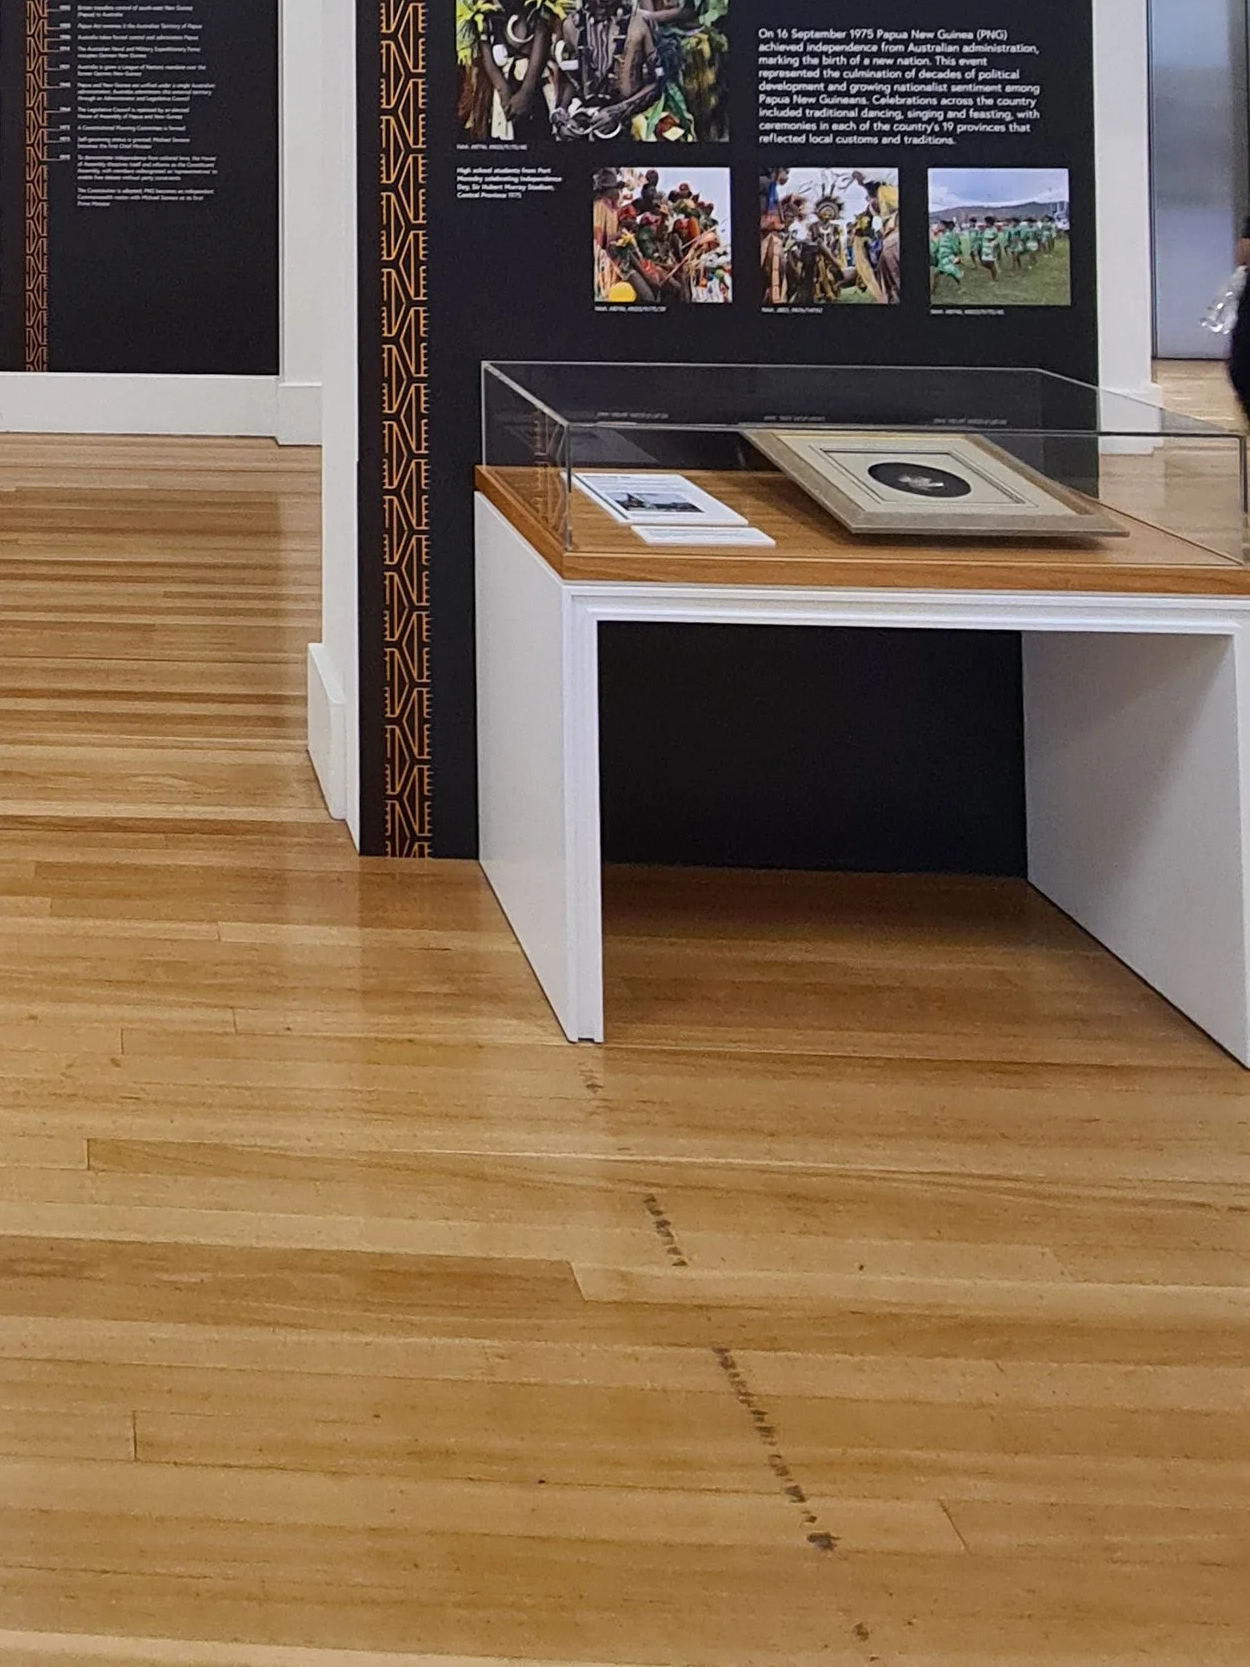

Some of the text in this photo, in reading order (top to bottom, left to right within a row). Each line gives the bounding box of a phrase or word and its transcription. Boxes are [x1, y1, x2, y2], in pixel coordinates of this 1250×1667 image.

[758, 28, 1007, 41] On 16 September 1975 Papua New Guinea (PNG)
[758, 42, 804, 52] achieved
[806, 42, 878, 55] independence
[880, 42, 905, 52] from
[907, 42, 959, 53] Australian
[758, 55, 799, 67] marking
[801, 55, 819, 65] the
[822, 55, 847, 65] birth
[849, 55, 860, 65] of
[872, 57, 894, 65] new
[934, 55, 956, 66] This
[958, 57, 987, 66] event
[758, 68, 1019, 81] represented the culmination of decades of political
[758, 81, 1040, 95] development and growing nationalist sentiment among
[759, 94, 790, 106] Papua
[793, 94, 816, 104] New
[872, 94, 937, 105] Celebrations
[940, 97, 973, 105] across
[977, 95, 993, 105] the
[997, 97, 1035, 108] country
[759, 107, 802, 117] included
[805, 107, 858, 118] traditional
[907, 108, 944, 121] singing
[946, 108, 966, 118] and
[1017, 108, 1039, 118] with
[758, 121, 817, 134] ceremonies
[831, 121, 857, 130] each
[858, 121, 870, 131] of
[873, 121, 891, 131] the
[892, 121, 940, 134] country's
[942, 121, 954, 131] 19
[956, 122, 1006, 134] provinces
[1008, 121, 1030, 132] that
[758, 134, 956, 145] reflected local customs and traditions.
